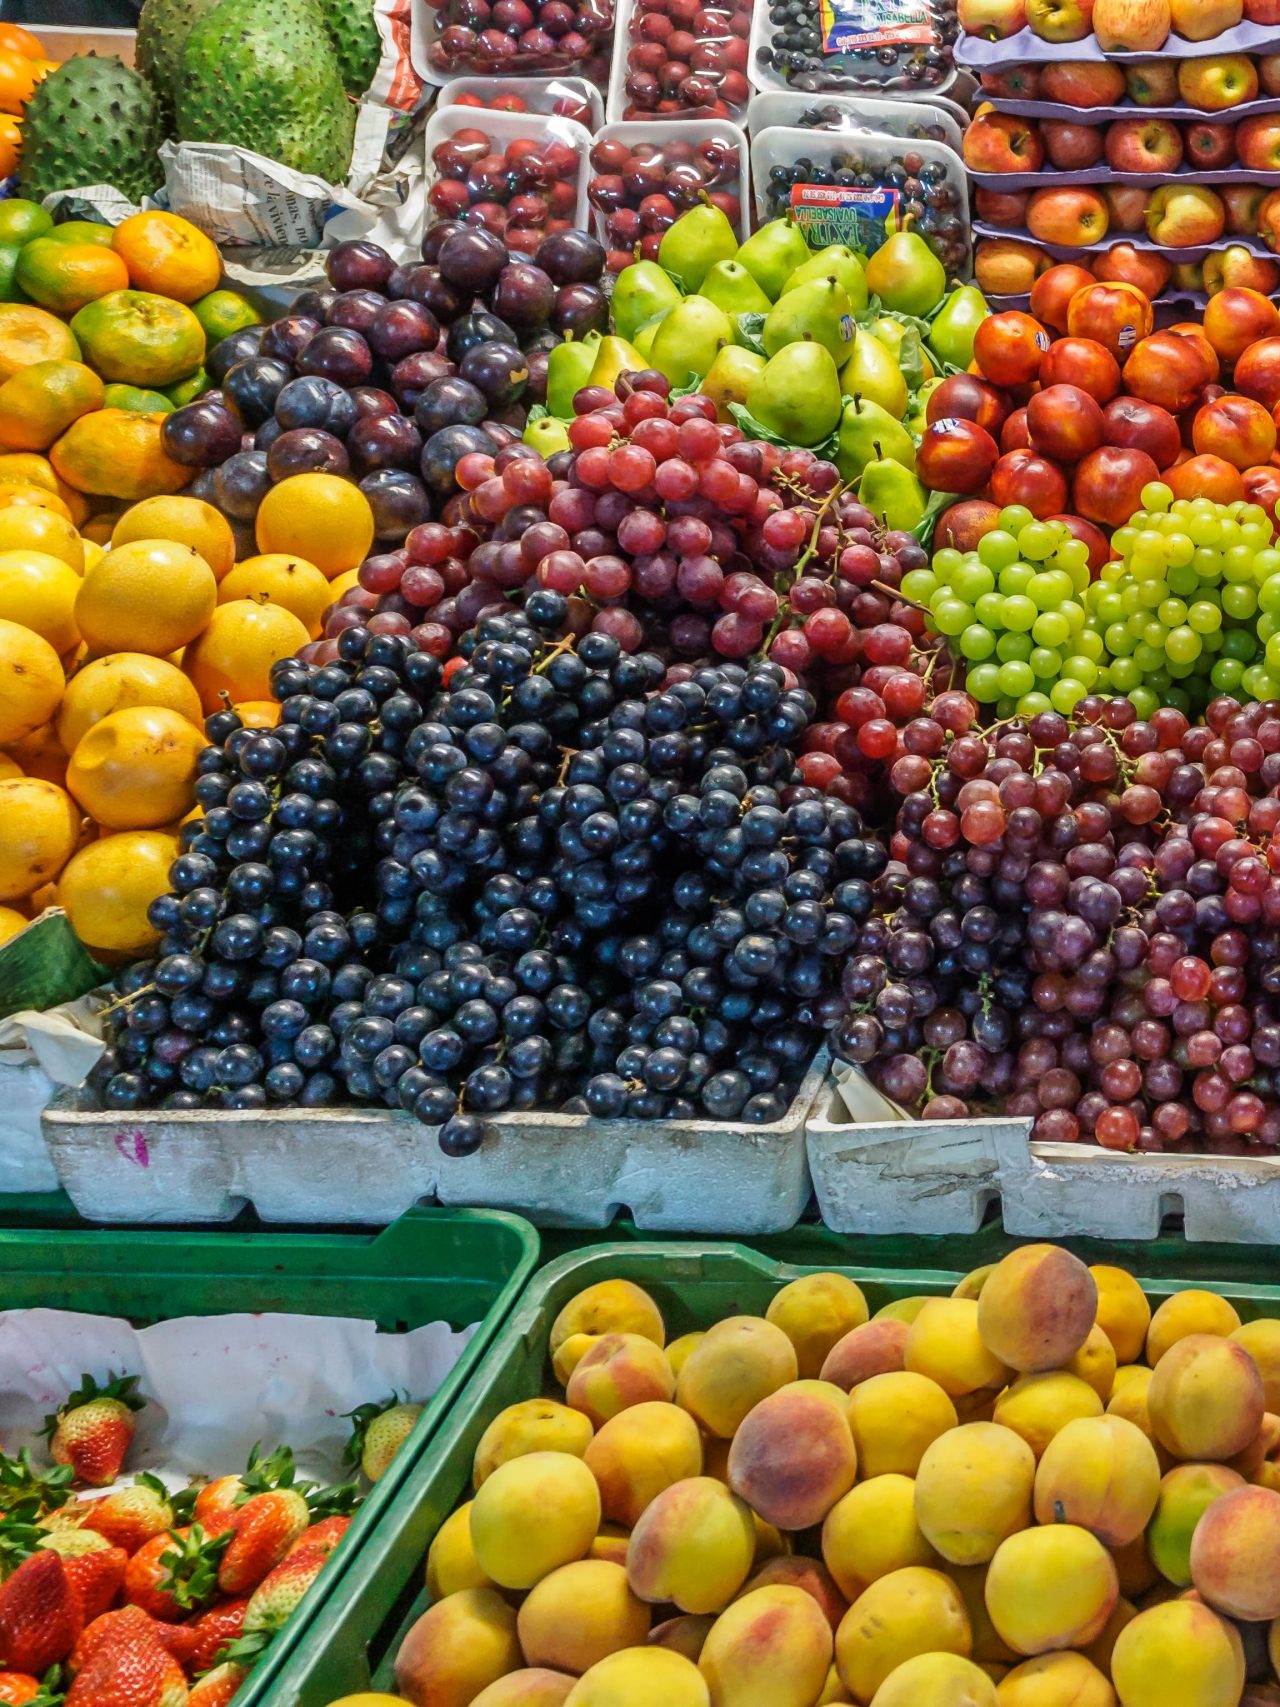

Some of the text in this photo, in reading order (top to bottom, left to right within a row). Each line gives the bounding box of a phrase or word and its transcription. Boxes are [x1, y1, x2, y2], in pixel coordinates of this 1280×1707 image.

[794, 206, 837, 221] ISABELLA
[295, 227, 309, 243] no
[799, 221, 861, 246] EXTRA
